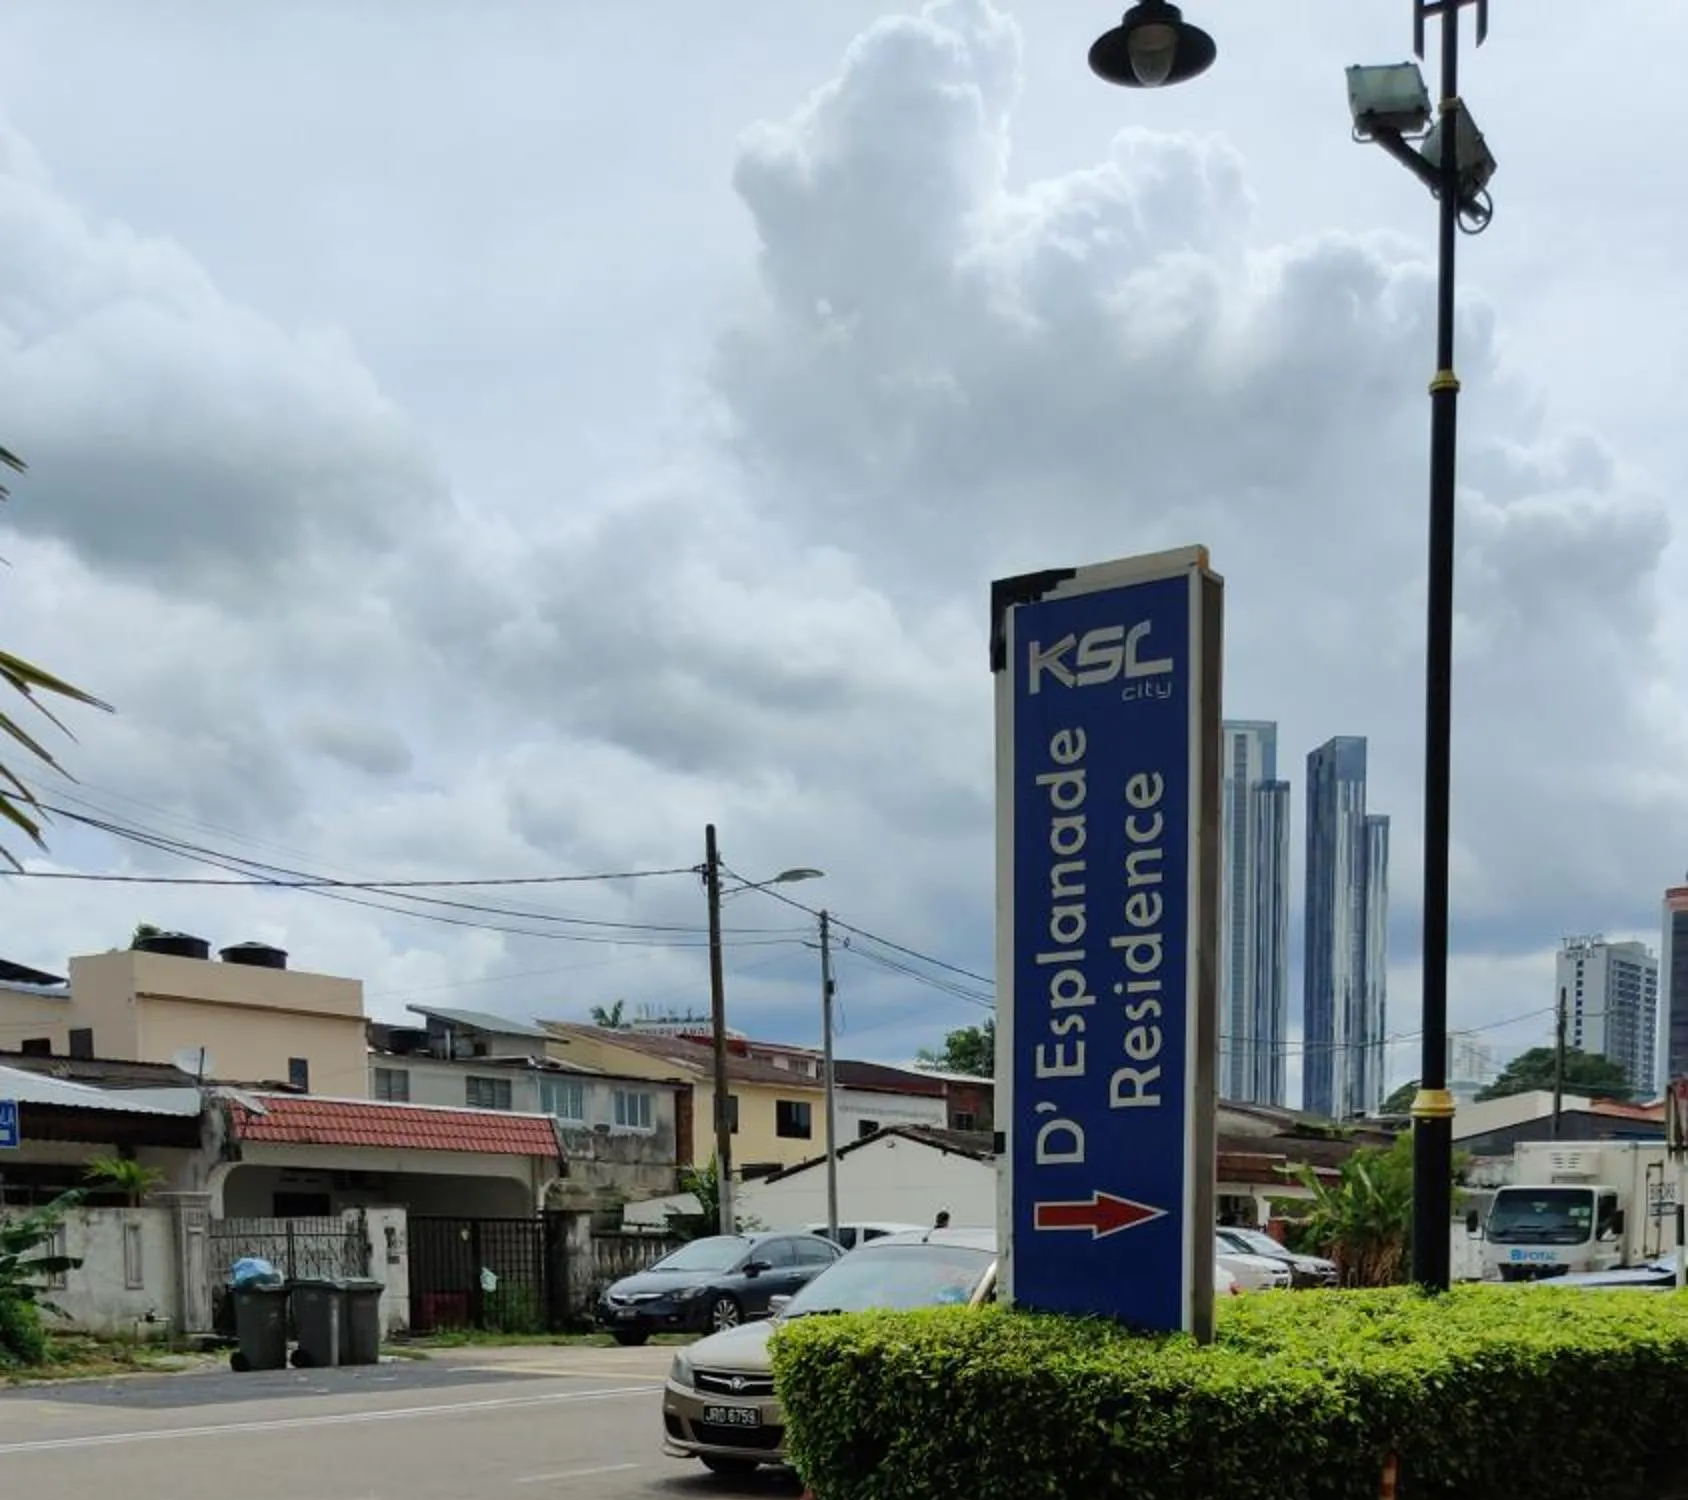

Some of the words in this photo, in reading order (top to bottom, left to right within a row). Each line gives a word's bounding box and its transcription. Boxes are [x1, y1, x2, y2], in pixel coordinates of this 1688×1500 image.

[1122, 680, 1172, 701] city
[1036, 727, 1095, 1078] Esplanade
[1110, 772, 1164, 1108] Residence
